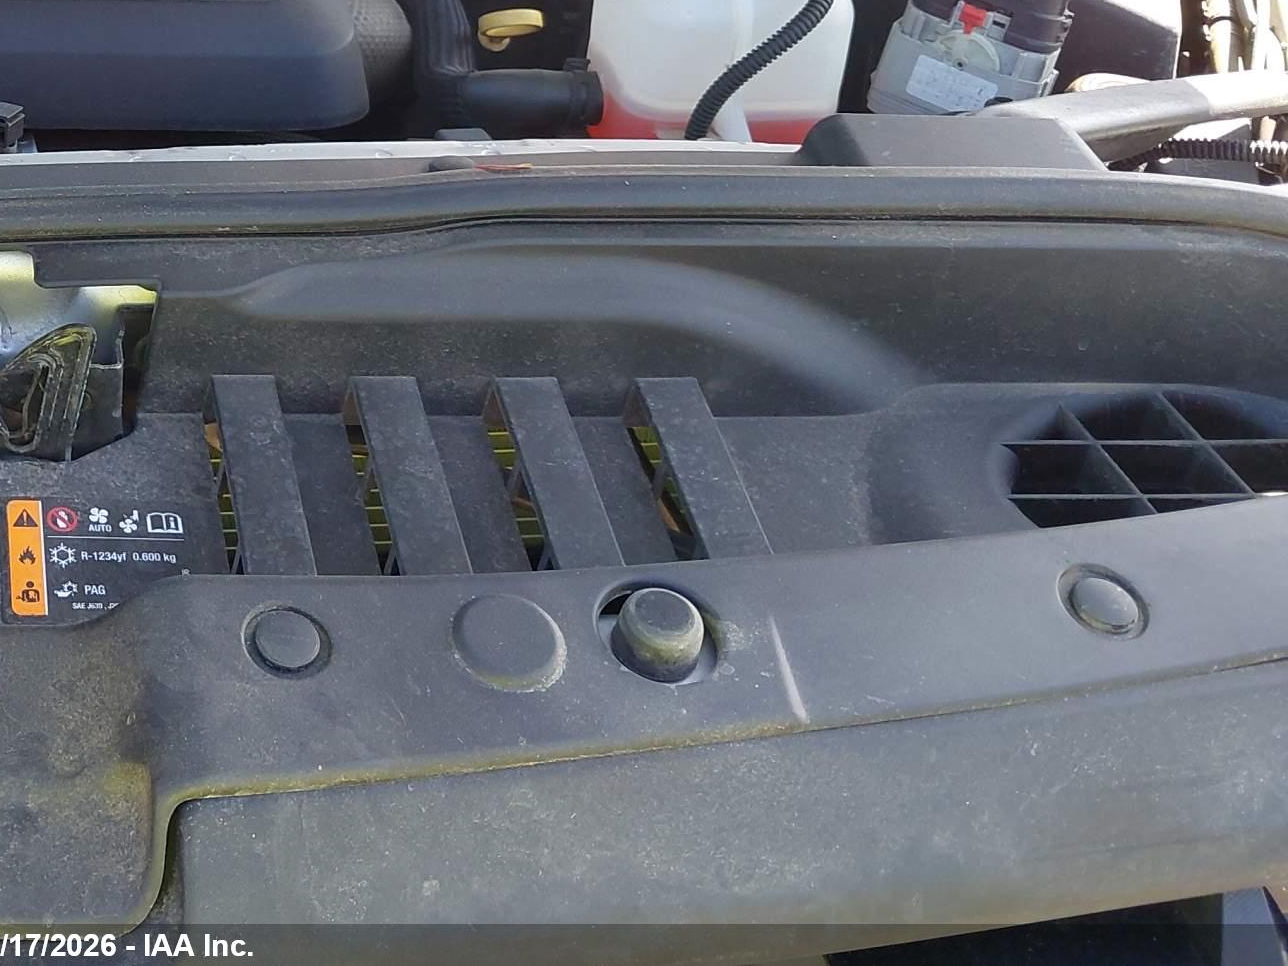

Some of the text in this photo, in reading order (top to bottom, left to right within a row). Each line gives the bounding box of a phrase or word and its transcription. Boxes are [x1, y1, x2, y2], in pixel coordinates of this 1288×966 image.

[88, 523, 113, 533] AUTO
[80, 550, 178, 565] R-1234yf 0.600 kg
[84, 584, 107, 596] PAG
